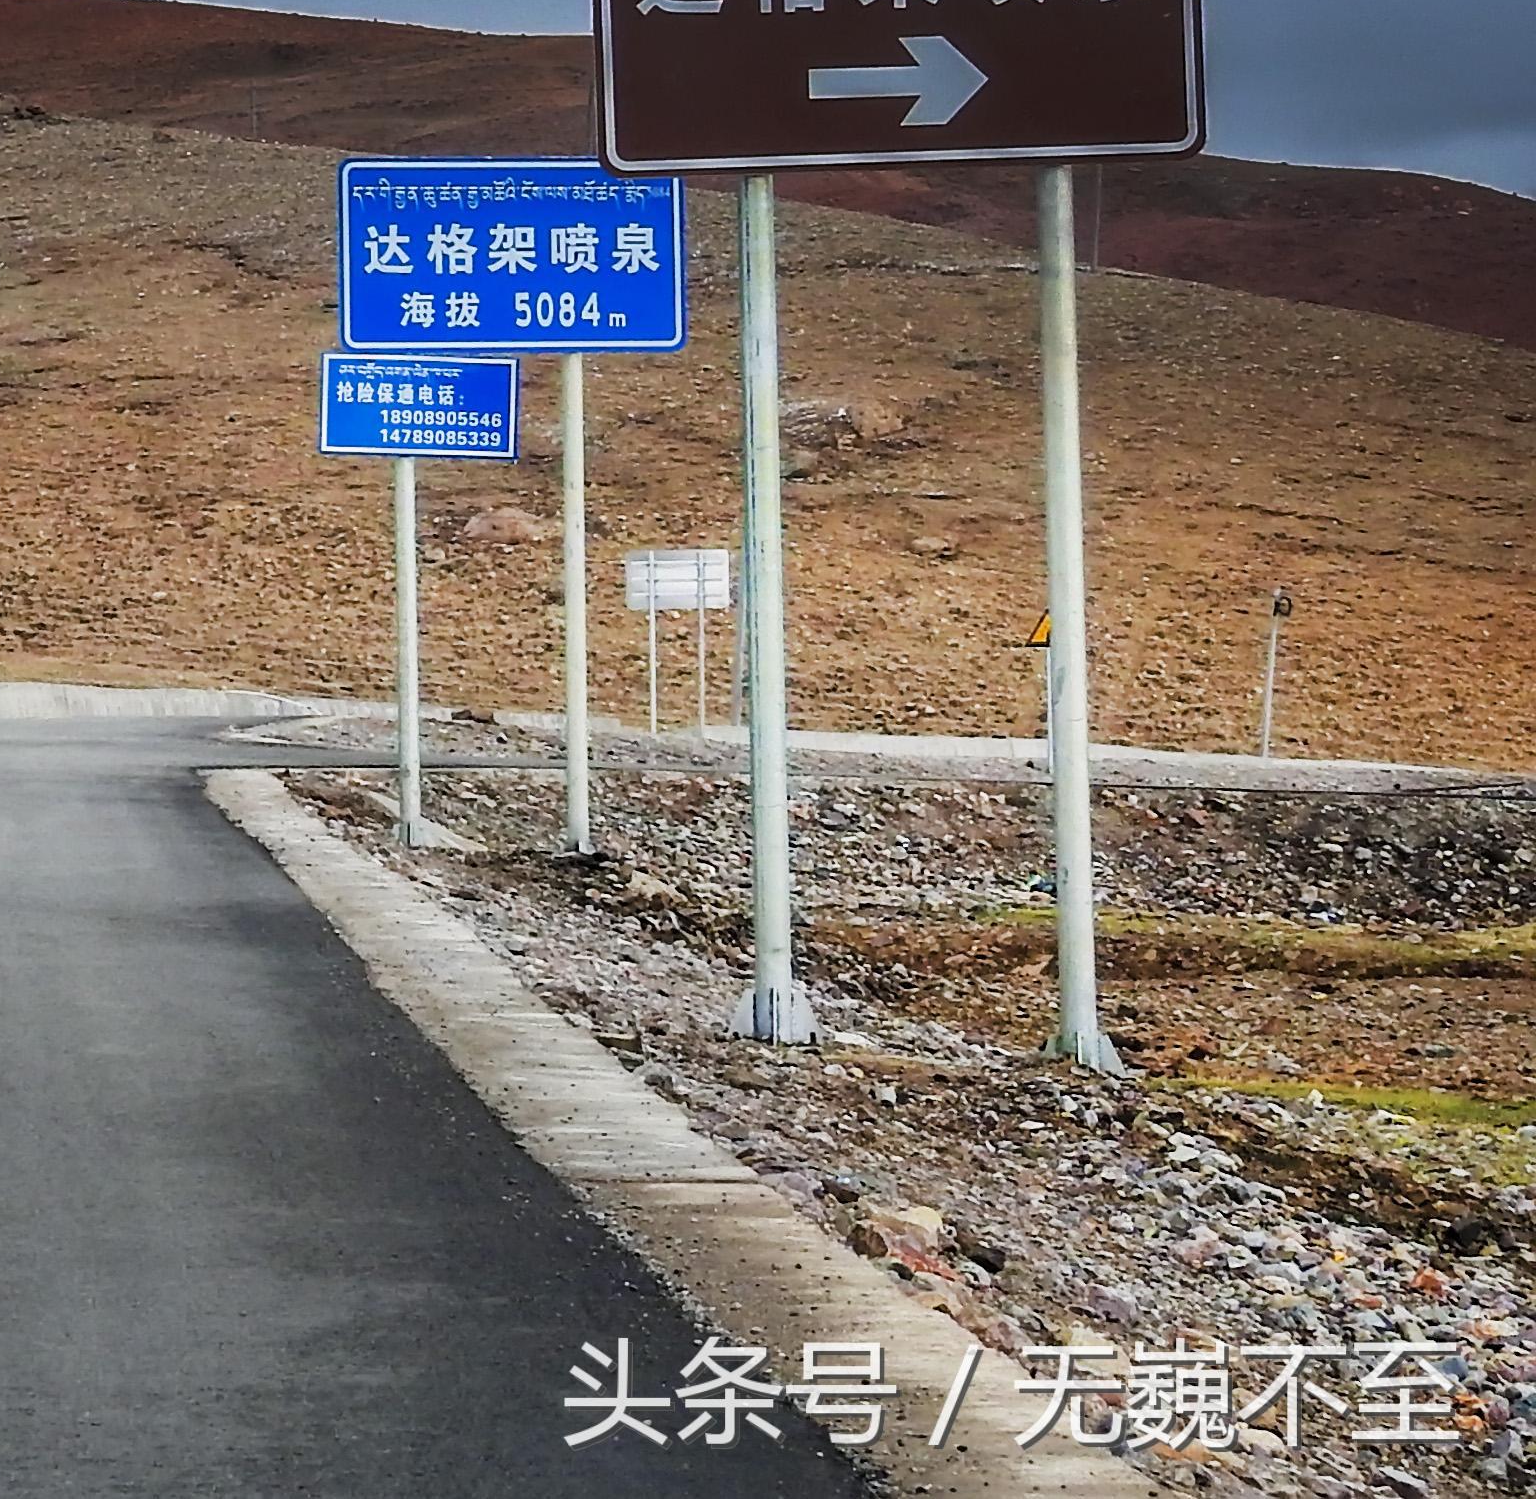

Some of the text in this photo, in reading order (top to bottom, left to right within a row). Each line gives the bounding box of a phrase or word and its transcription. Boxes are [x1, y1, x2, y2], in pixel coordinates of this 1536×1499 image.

[363, 222, 661, 276] 达格架喷泉
[400, 291, 481, 329] 海拔
[380, 408, 502, 428] 18908905546
[379, 428, 501, 447] 14789085339
